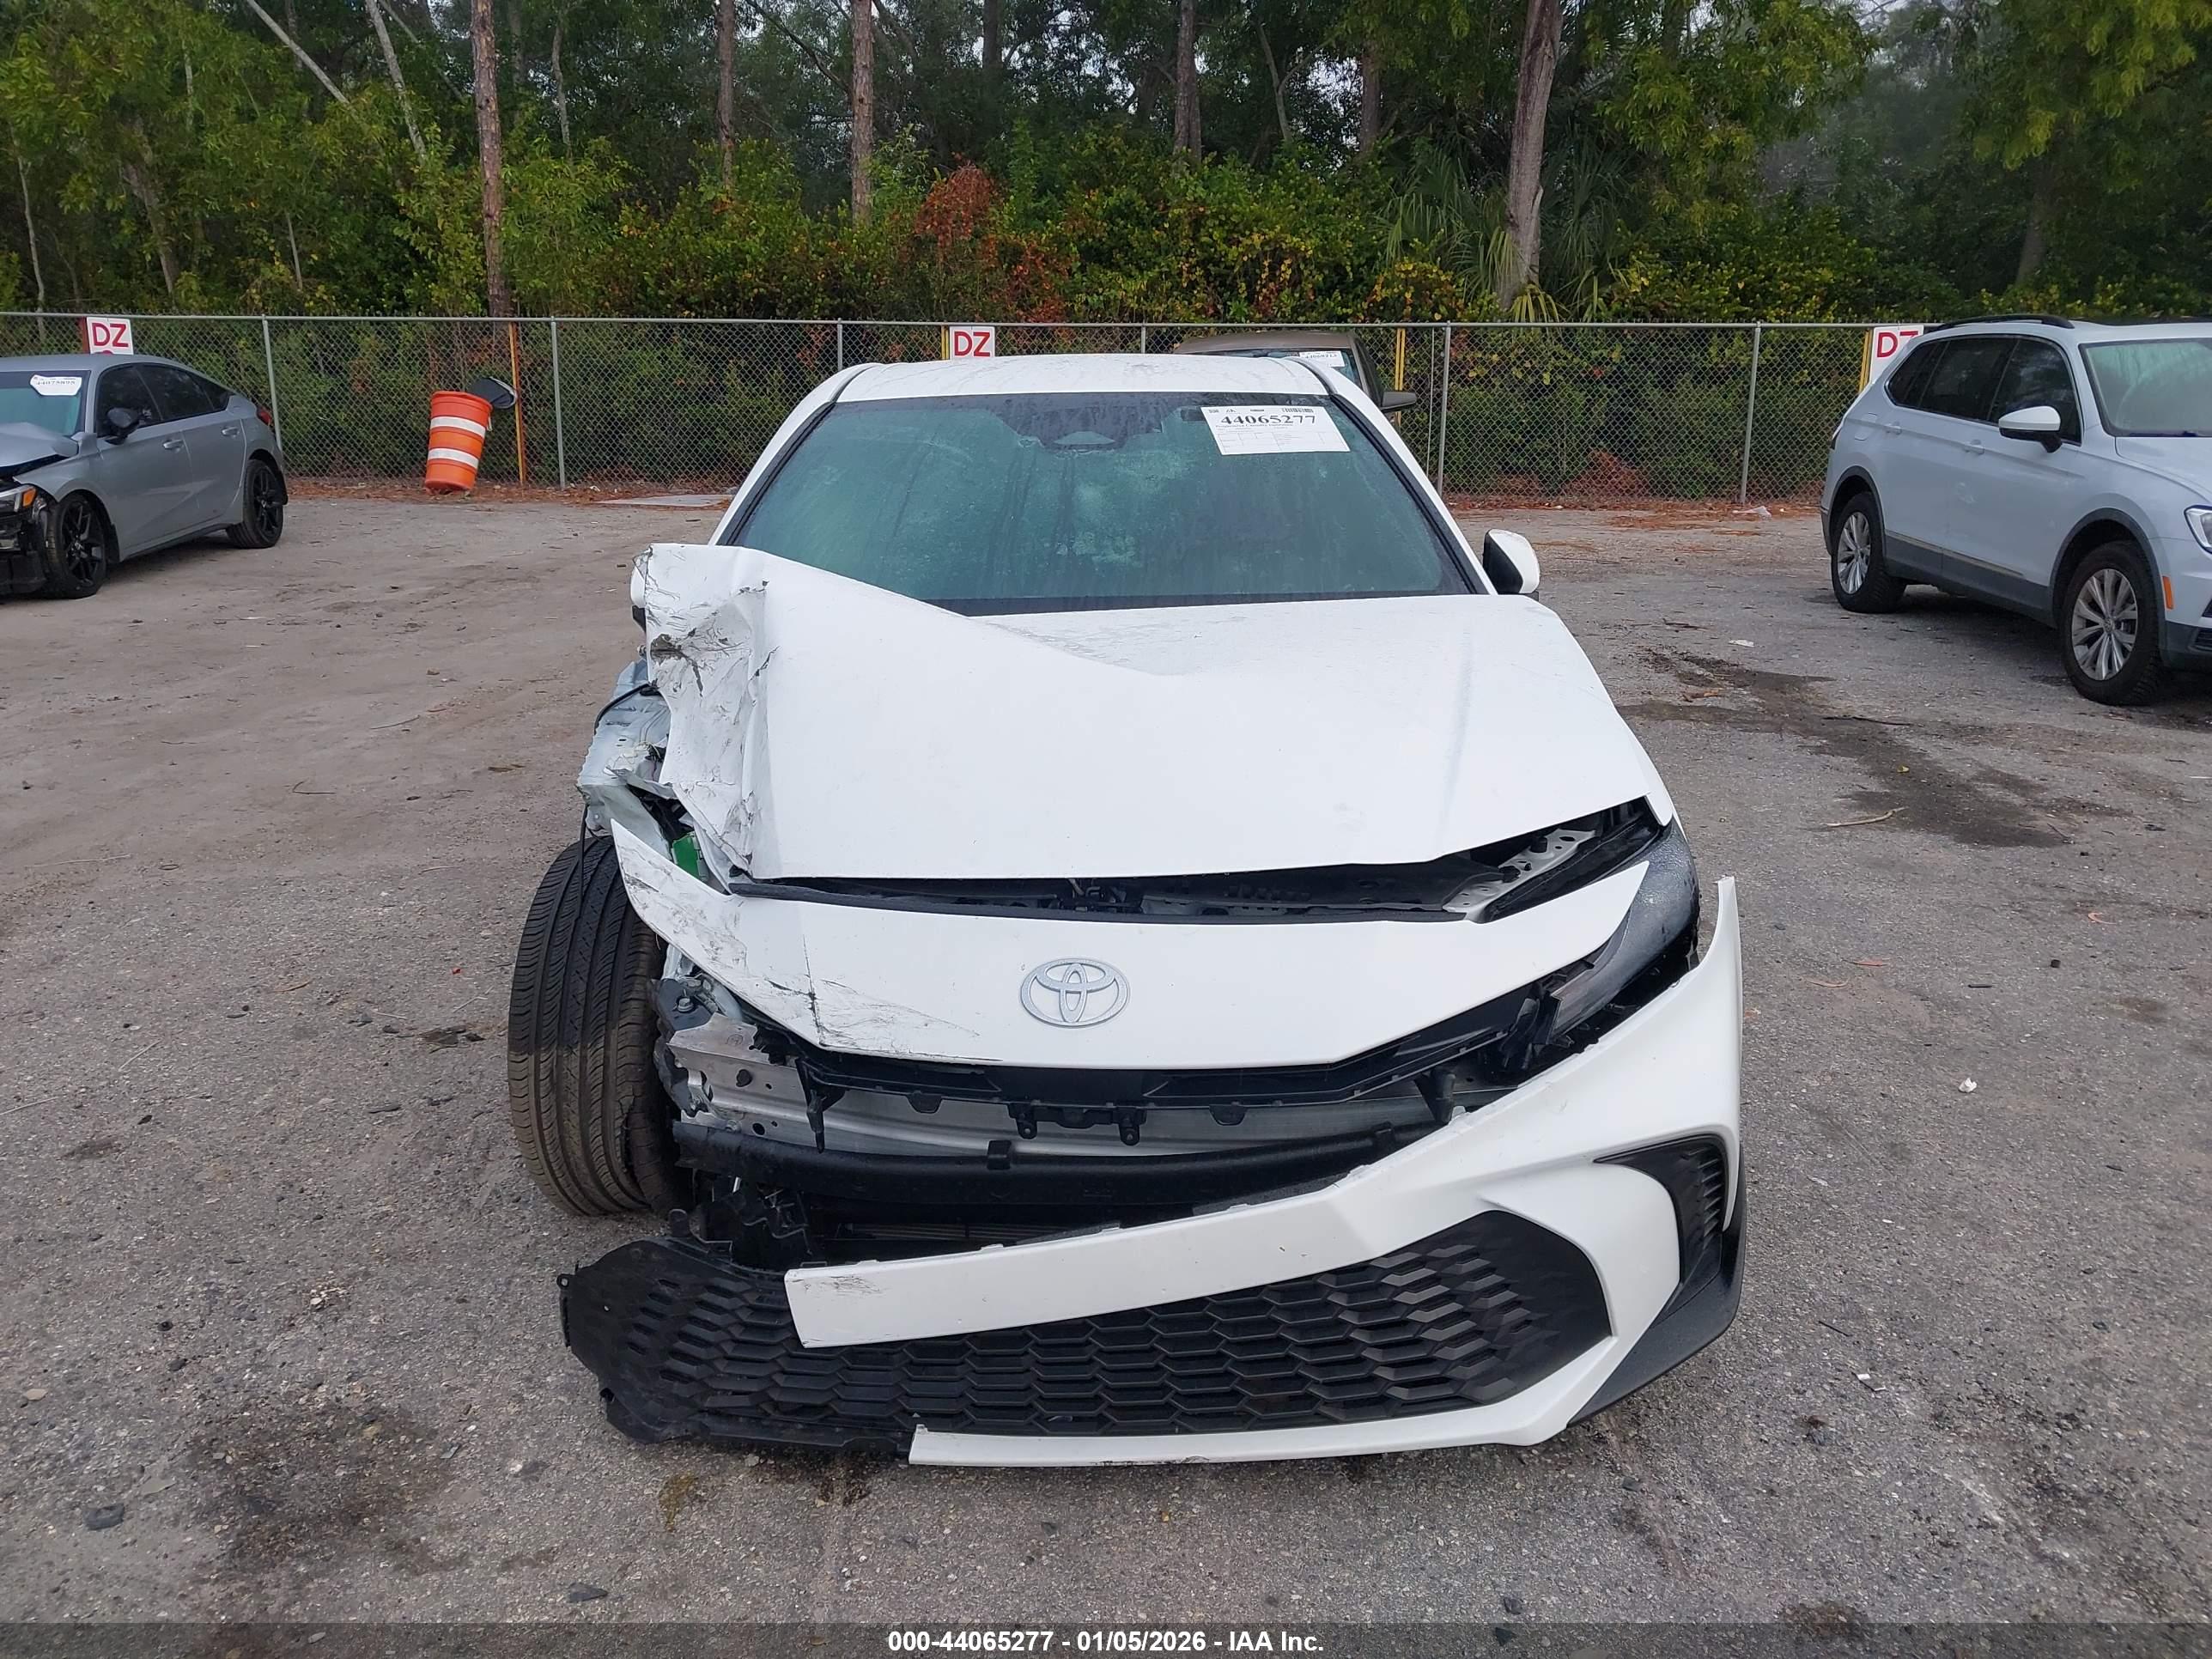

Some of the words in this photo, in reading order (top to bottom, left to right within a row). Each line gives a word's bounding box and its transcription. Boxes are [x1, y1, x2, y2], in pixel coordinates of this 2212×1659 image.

[92, 322, 129, 348] DZ
[954, 331, 991, 357] DZ
[1221, 415, 1316, 425] 44065277
